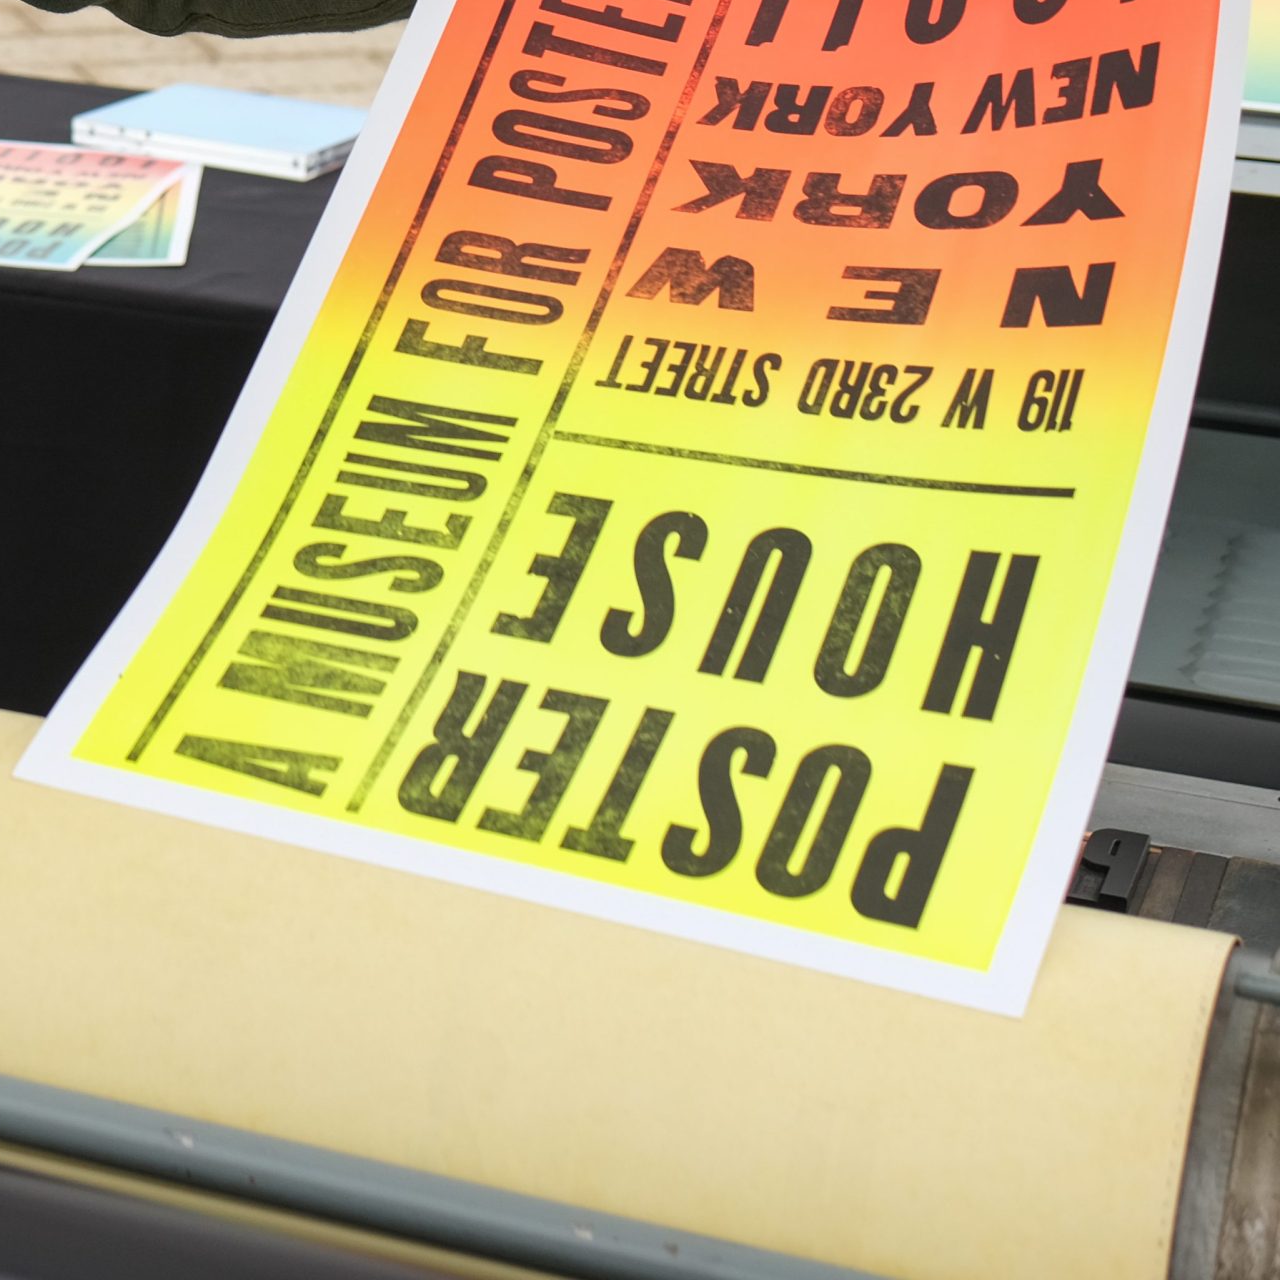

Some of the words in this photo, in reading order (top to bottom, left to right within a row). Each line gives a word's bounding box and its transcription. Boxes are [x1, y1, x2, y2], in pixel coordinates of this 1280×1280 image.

[696, 76, 937, 138] YORK
[961, 41, 1161, 135] NEW
[671, 158, 1125, 230] YORK
[395, 230, 590, 376] FOR
[626, 247, 1116, 328] NEW
[594, 335, 783, 407] STREET
[797, 358, 934, 424] 23RD
[940, 368, 995, 430] W
[1017, 369, 1085, 433] 119
[220, 393, 519, 718] MUSEUM
[490, 491, 1041, 722] HOUSE
[176, 734, 340, 797] A
[397, 670, 976, 930] POSTER
